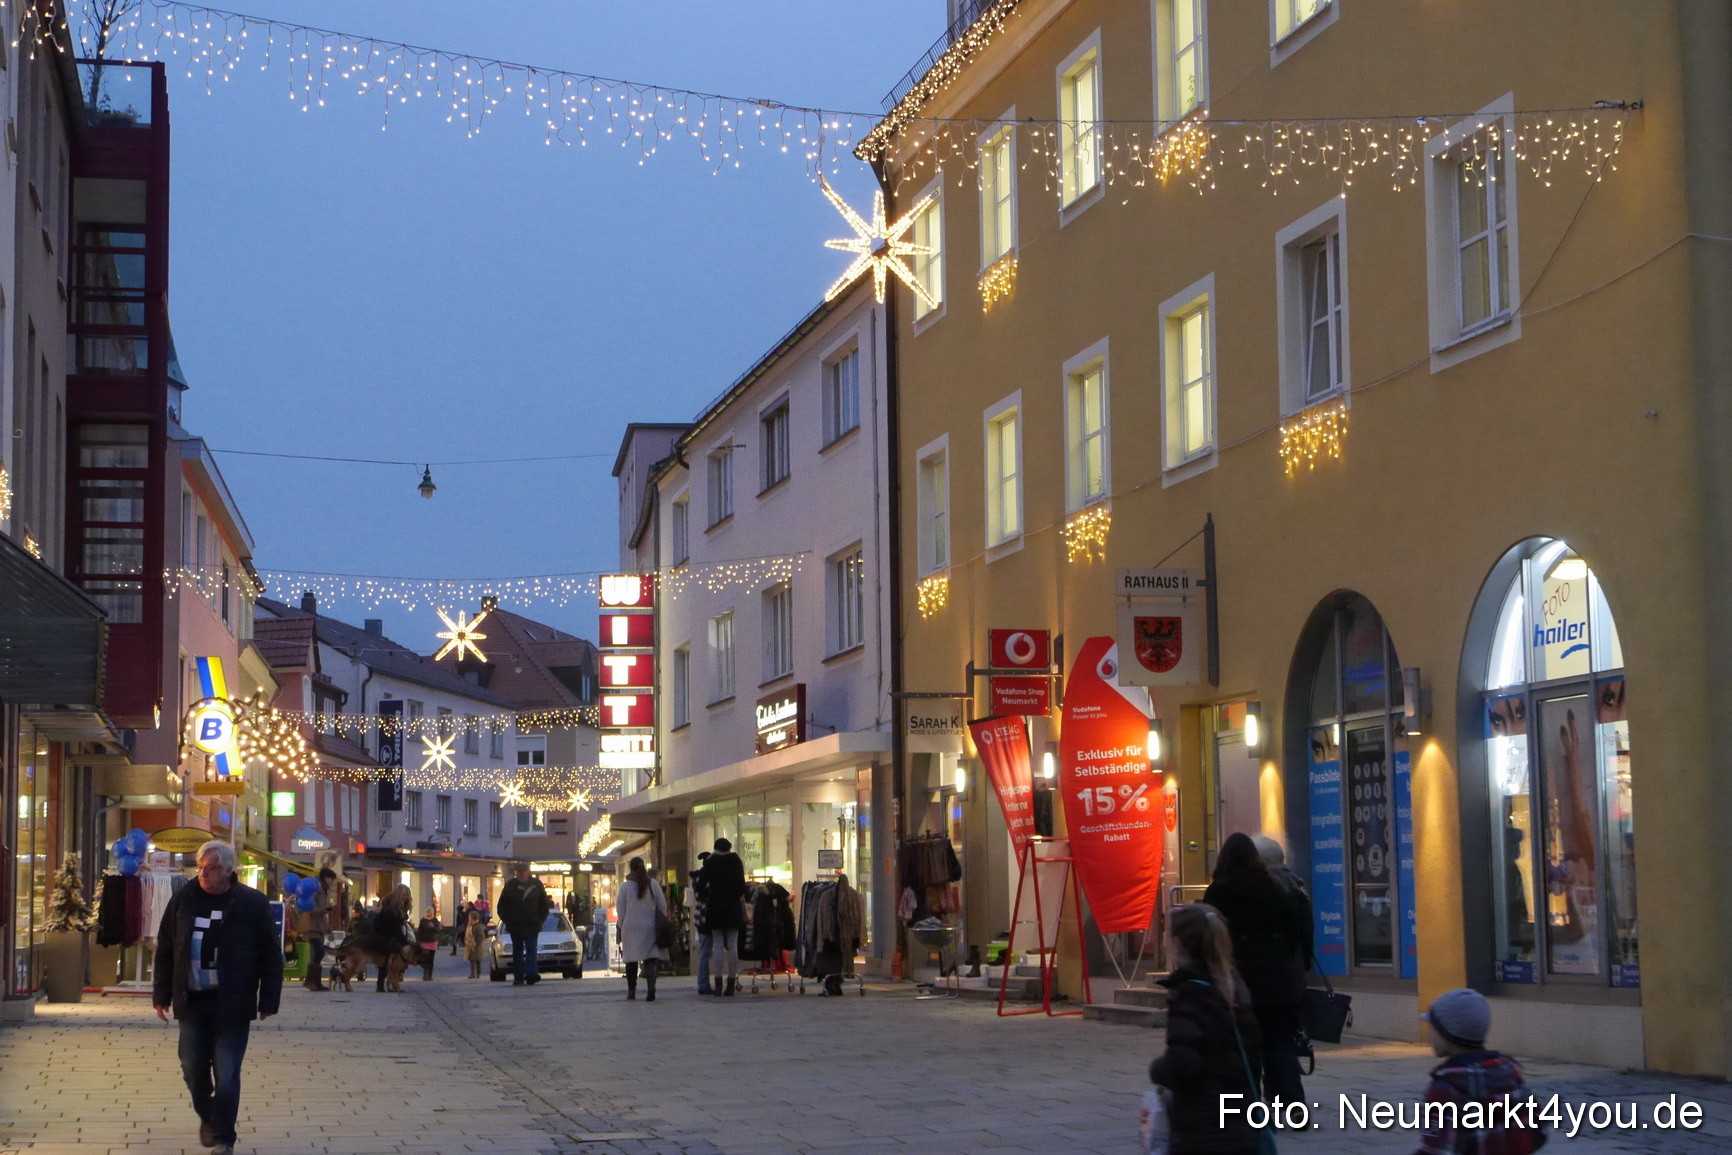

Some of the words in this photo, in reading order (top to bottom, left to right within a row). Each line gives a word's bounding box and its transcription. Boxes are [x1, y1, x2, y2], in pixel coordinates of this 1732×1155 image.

[1125, 575, 1180, 589] RATHAUS
[1182, 576, 1189, 589] II
[1541, 582, 1570, 625] FOTO
[1533, 618, 1586, 648] hailer
[601, 576, 641, 725] WITT
[995, 687, 1027, 695] Vodafone
[1028, 688, 1045, 697] Shop
[1002, 697, 1038, 705] Neumarkt
[910, 715, 948, 729] SARAH
[950, 716, 960, 729] K
[200, 718, 223, 741] B
[1077, 747, 1124, 761] Exklusiv
[1125, 746, 1143, 757] für
[1075, 762, 1147, 777] Selbständige
[1396, 760, 1411, 774] Bewe
[1309, 769, 1341, 784] Passbilde
[1080, 820, 1152, 833] Geschäftskunden-
[1104, 833, 1130, 842] Rabatt
